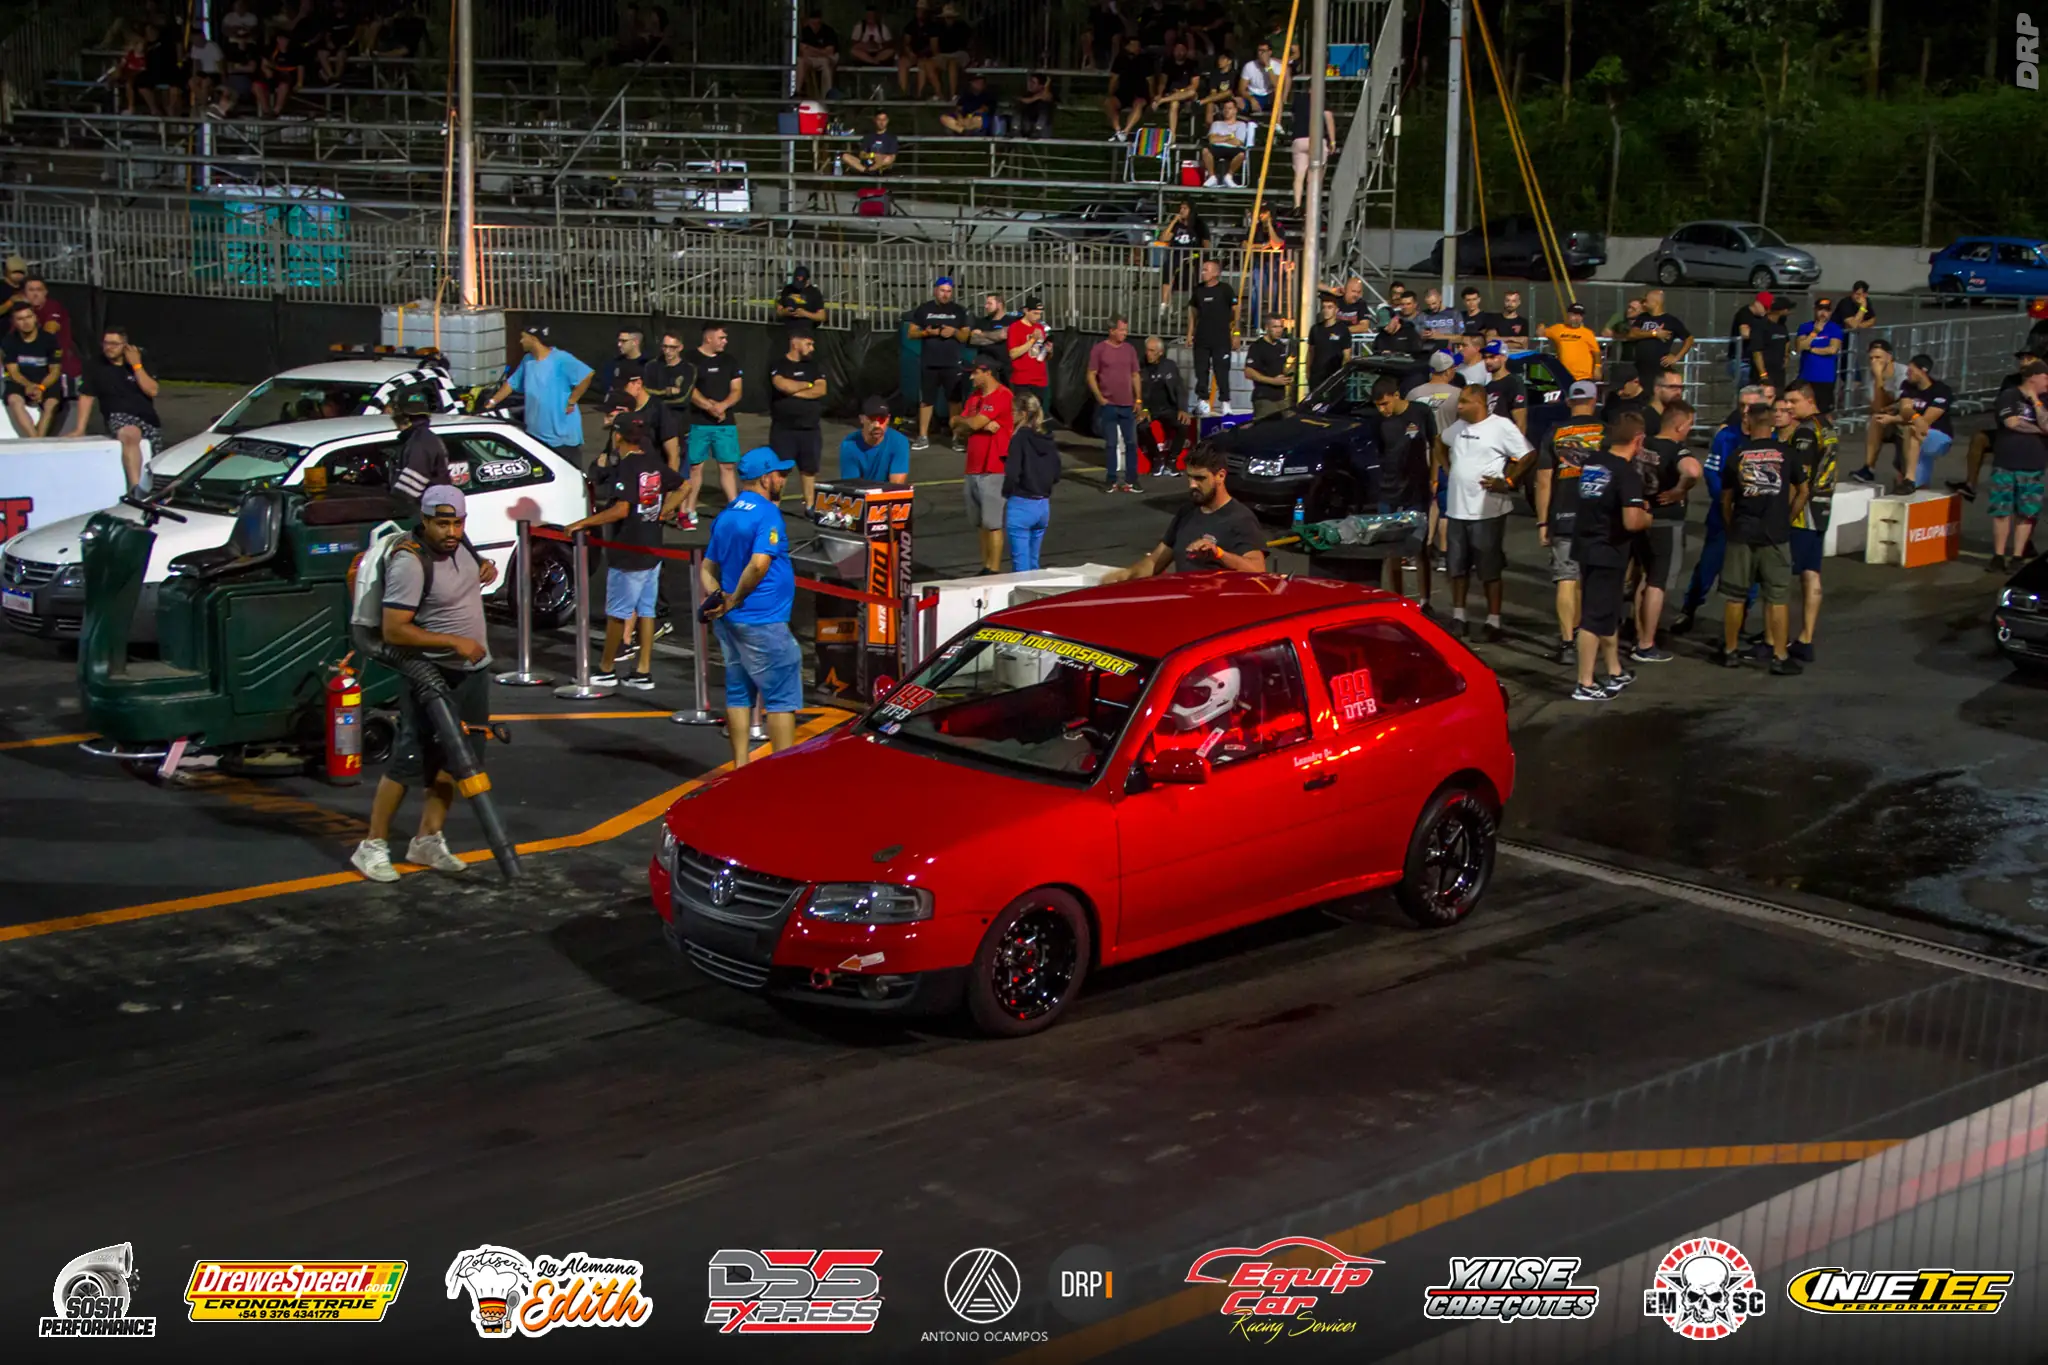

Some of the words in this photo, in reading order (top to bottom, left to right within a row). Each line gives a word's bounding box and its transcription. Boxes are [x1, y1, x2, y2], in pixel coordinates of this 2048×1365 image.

[900, 531, 912, 597] ETANO
[877, 605, 887, 634] NITR
[972, 629, 1025, 644] SERRO
[1022, 634, 1137, 676] MOTORSPORT
[885, 683, 937, 711] 199
[1344, 698, 1377, 719] DT-B
